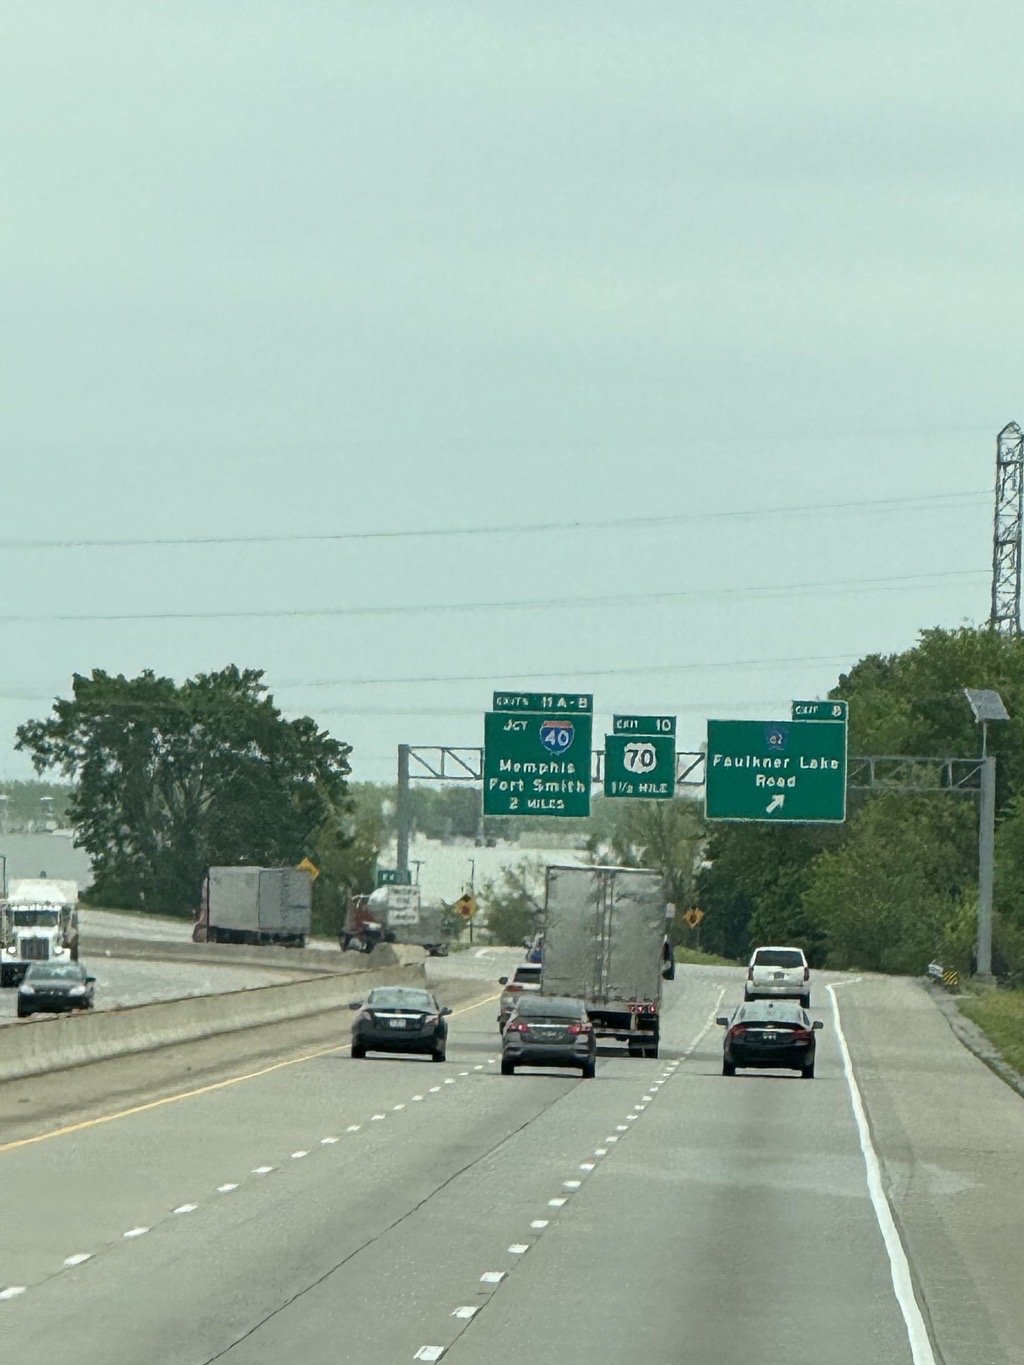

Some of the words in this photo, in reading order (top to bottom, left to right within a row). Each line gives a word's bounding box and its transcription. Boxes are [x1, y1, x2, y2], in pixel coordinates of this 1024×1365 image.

[503, 719, 528, 731] JCT
[656, 718, 671, 732] 10
[544, 729, 570, 747] 40
[625, 748, 654, 768] 70
[713, 754, 790, 769] Faulkner
[800, 756, 839, 770] Lake
[499, 759, 576, 775] Memphis
[489, 778, 525, 792] Fort
[533, 779, 586, 793] Smith
[755, 774, 796, 788] Road
[509, 797, 519, 810] 2
[527, 799, 565, 809] MILES
